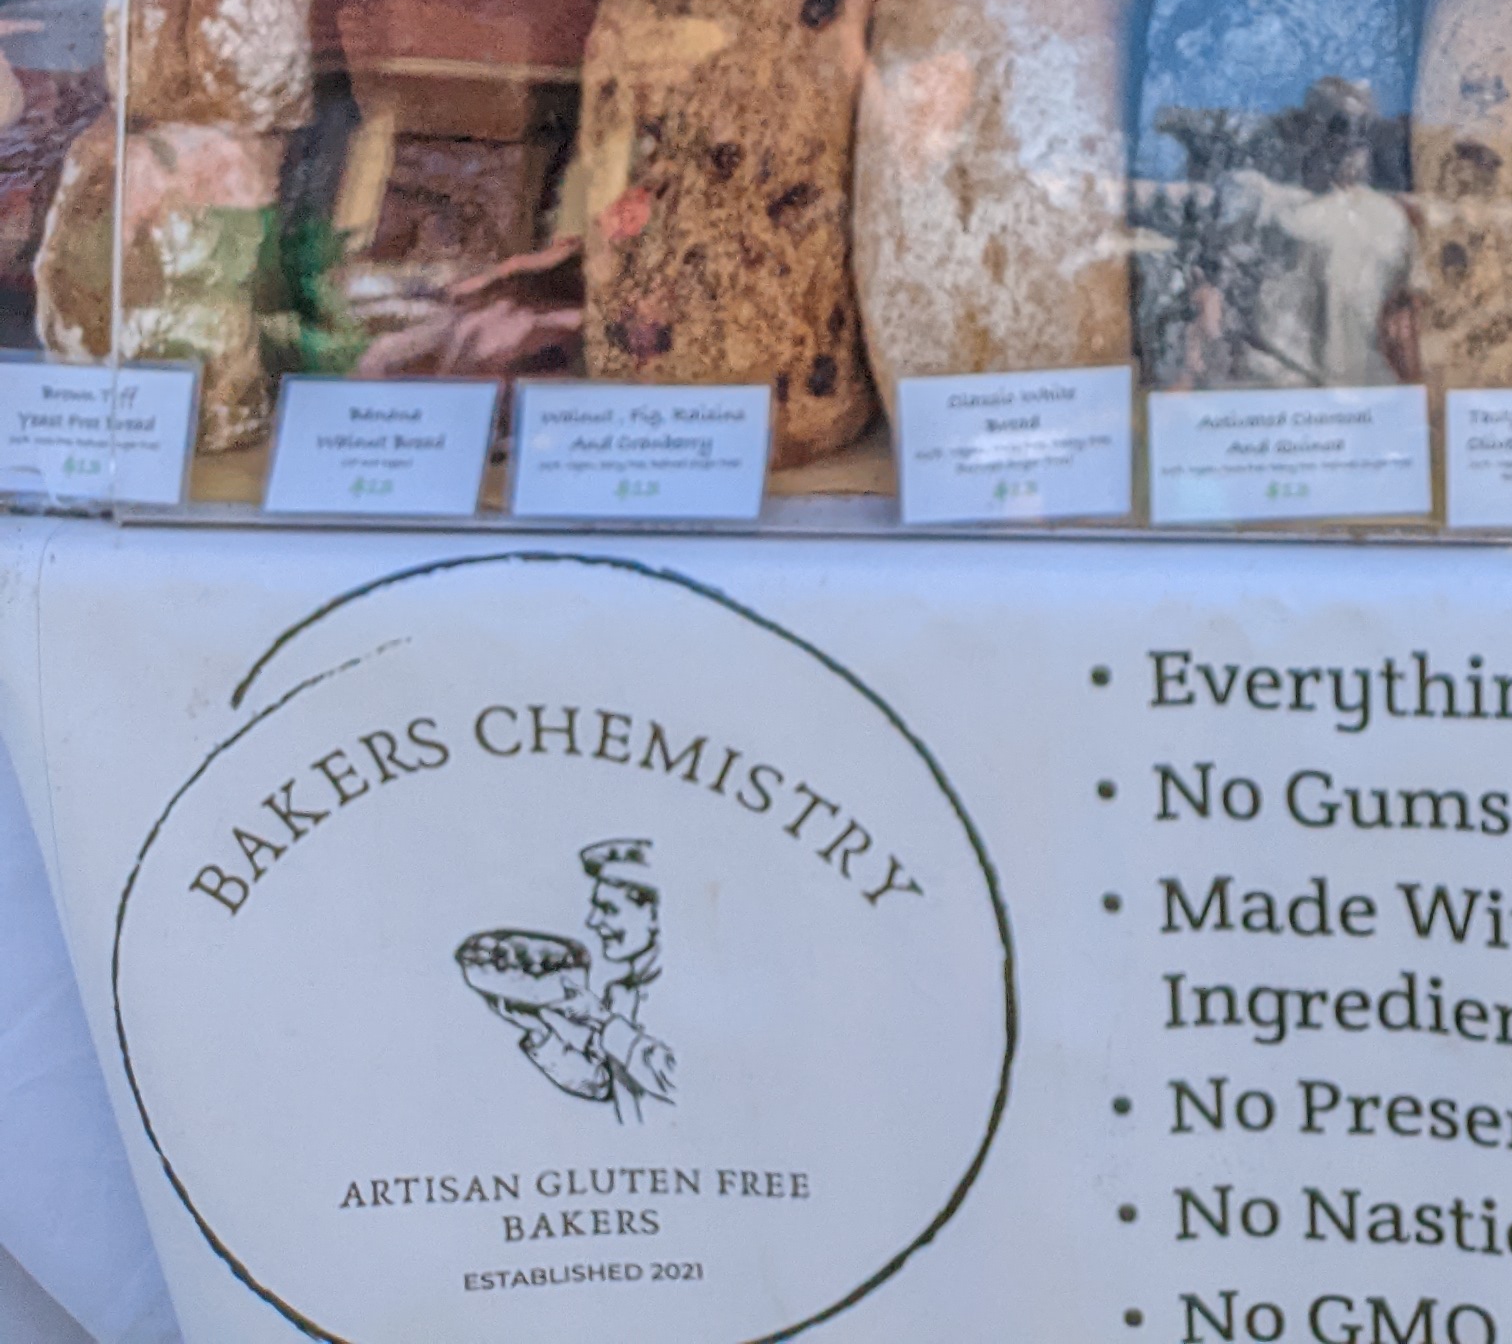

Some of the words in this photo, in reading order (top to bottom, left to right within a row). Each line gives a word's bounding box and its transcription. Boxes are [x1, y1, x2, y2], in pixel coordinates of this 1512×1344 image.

[100, 385, 139, 408] Tff
[190, 718, 451, 916] BAKERS
[474, 704, 925, 909] CHEMISTRY
[1153, 762, 1263, 823] No
[1285, 769, 1512, 838] Gums
[1158, 876, 1378, 939] Made
[1168, 1076, 1277, 1136] No
[339, 1173, 520, 1210] ARTISAN
[536, 1168, 703, 1200] GLUTEN
[717, 1168, 811, 1200] FREE
[1174, 1184, 1280, 1240] No
[503, 1210, 662, 1244] BAKERS
[463, 1263, 645, 1293] ESTABLISHED
[651, 1261, 705, 1284] 2021
[1178, 1289, 1285, 1344] No
[1308, 1294, 1497, 1344] GMO
